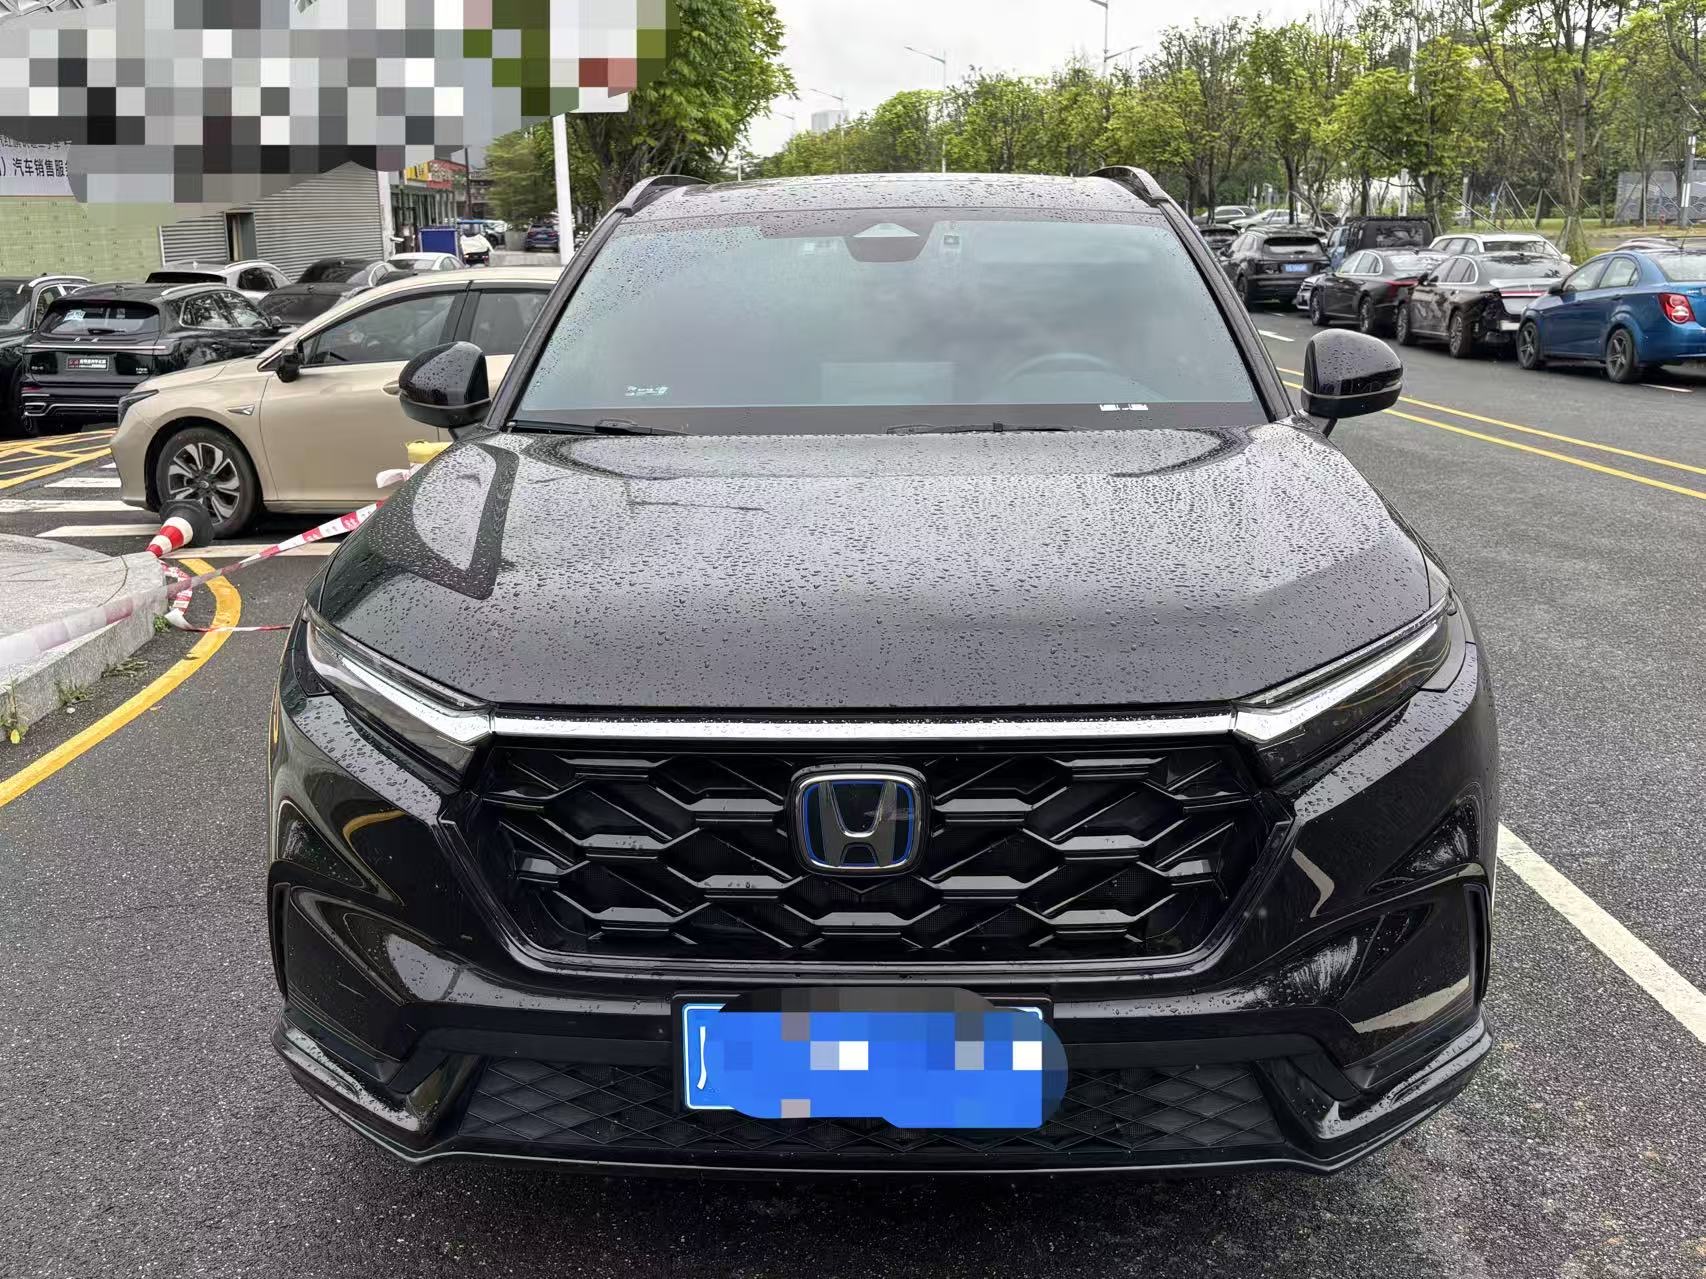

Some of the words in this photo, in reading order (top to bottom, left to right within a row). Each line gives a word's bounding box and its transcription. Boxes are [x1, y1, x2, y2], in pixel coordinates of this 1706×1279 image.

[0, 156, 69, 177] ）汽车销售服
